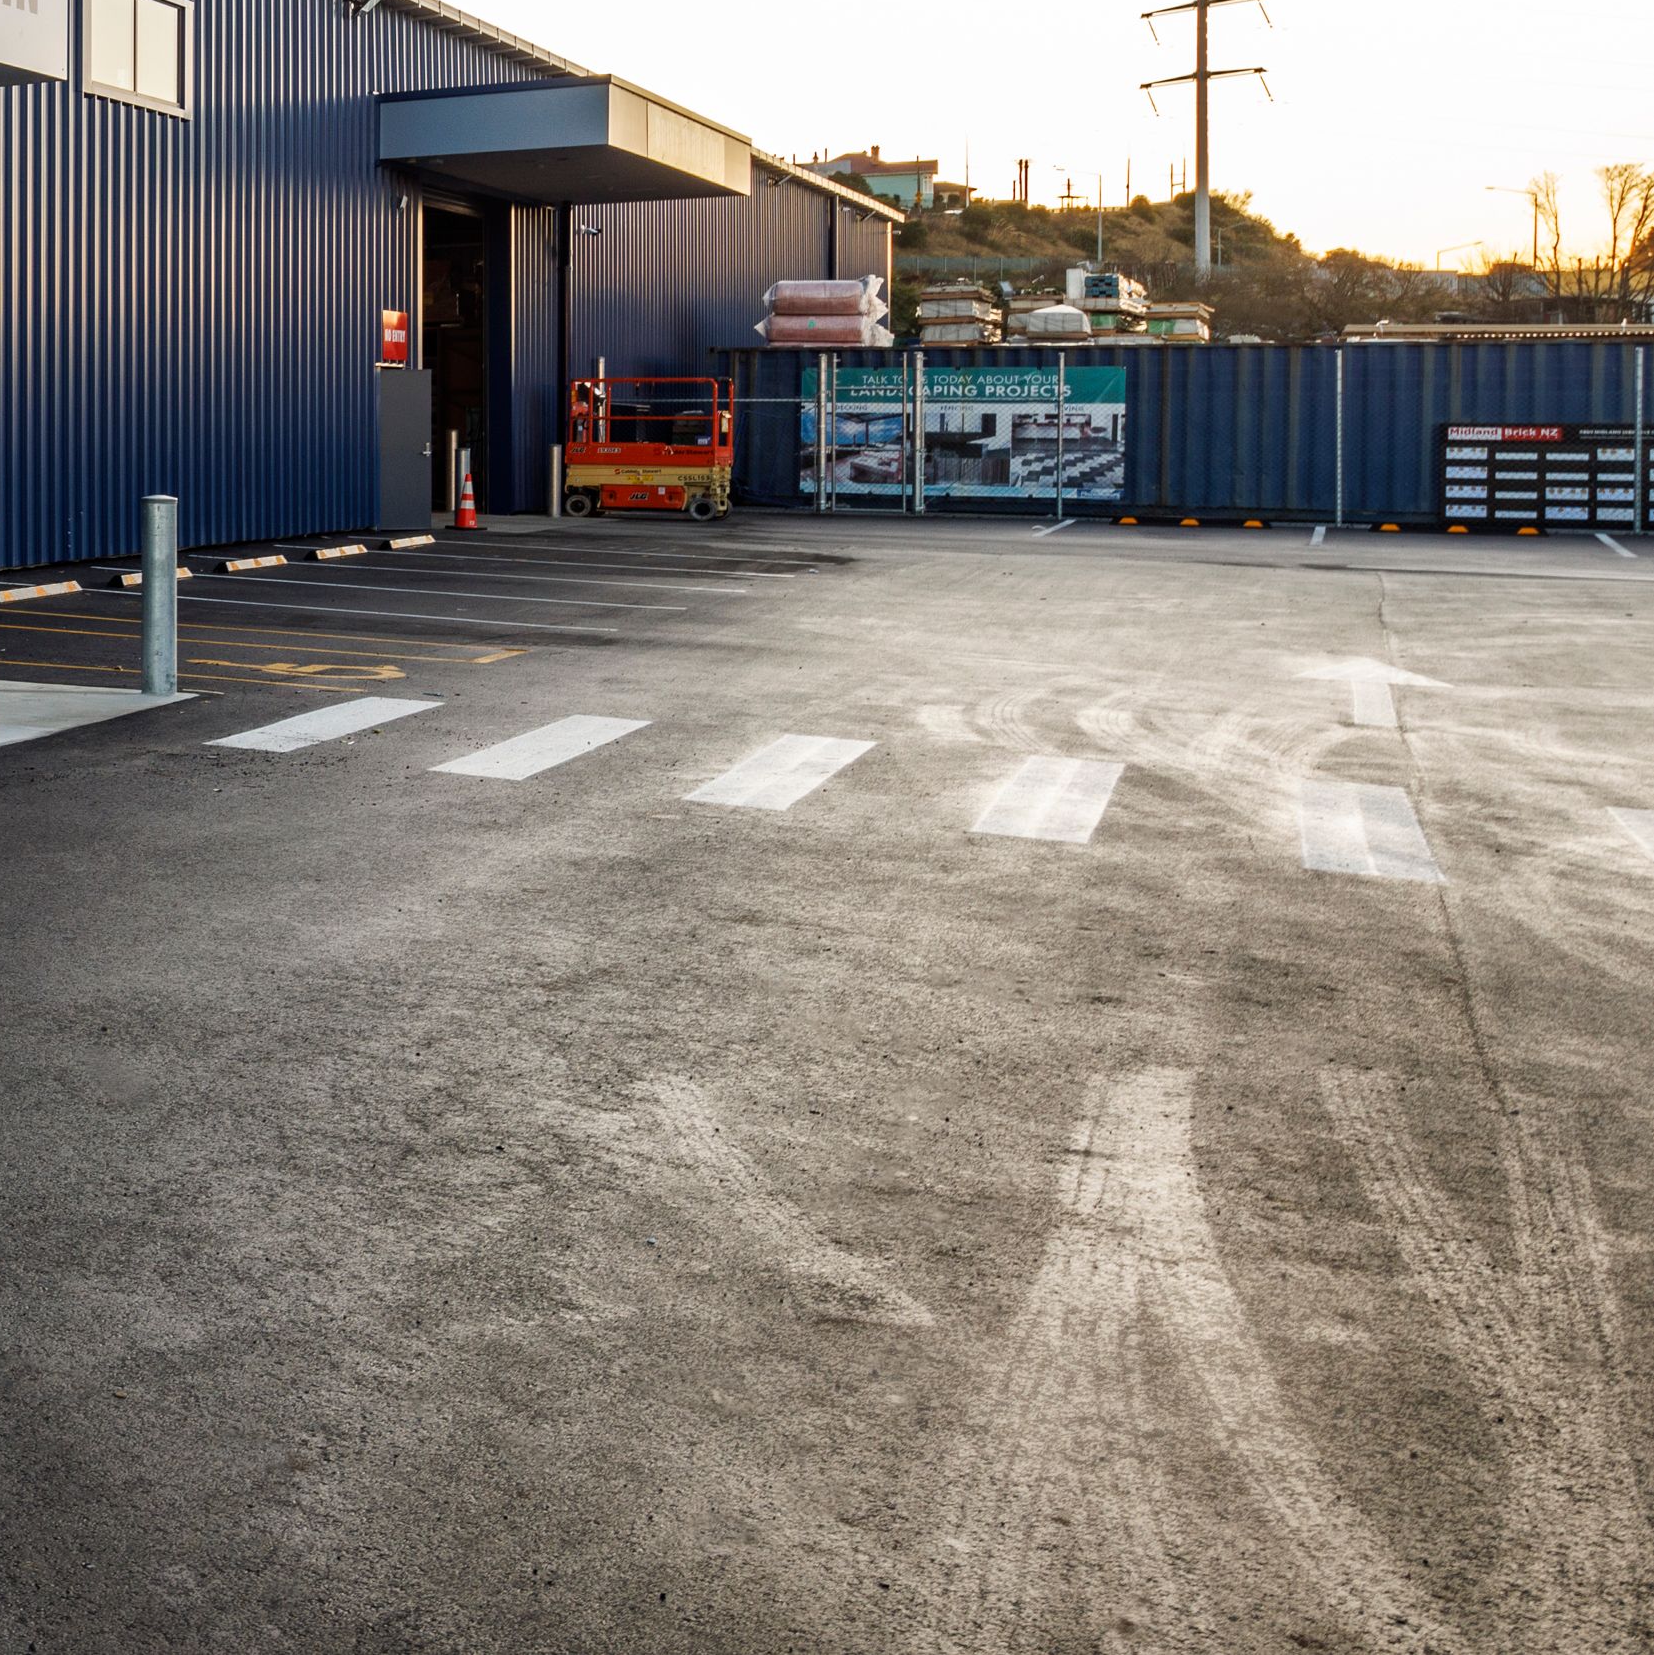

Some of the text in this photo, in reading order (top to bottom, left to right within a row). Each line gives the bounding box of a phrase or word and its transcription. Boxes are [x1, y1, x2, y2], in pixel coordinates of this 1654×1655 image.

[384, 328, 406, 343] NO ENTRY
[862, 375, 889, 385] TALK
[933, 374, 973, 384] TODAY
[976, 374, 1020, 384] ABOUT
[1024, 374, 1060, 384] YOUR
[984, 384, 1072, 397] PROJECTS
[1504, 427, 1536, 437] Brick
[1540, 428, 1559, 437] NZ
